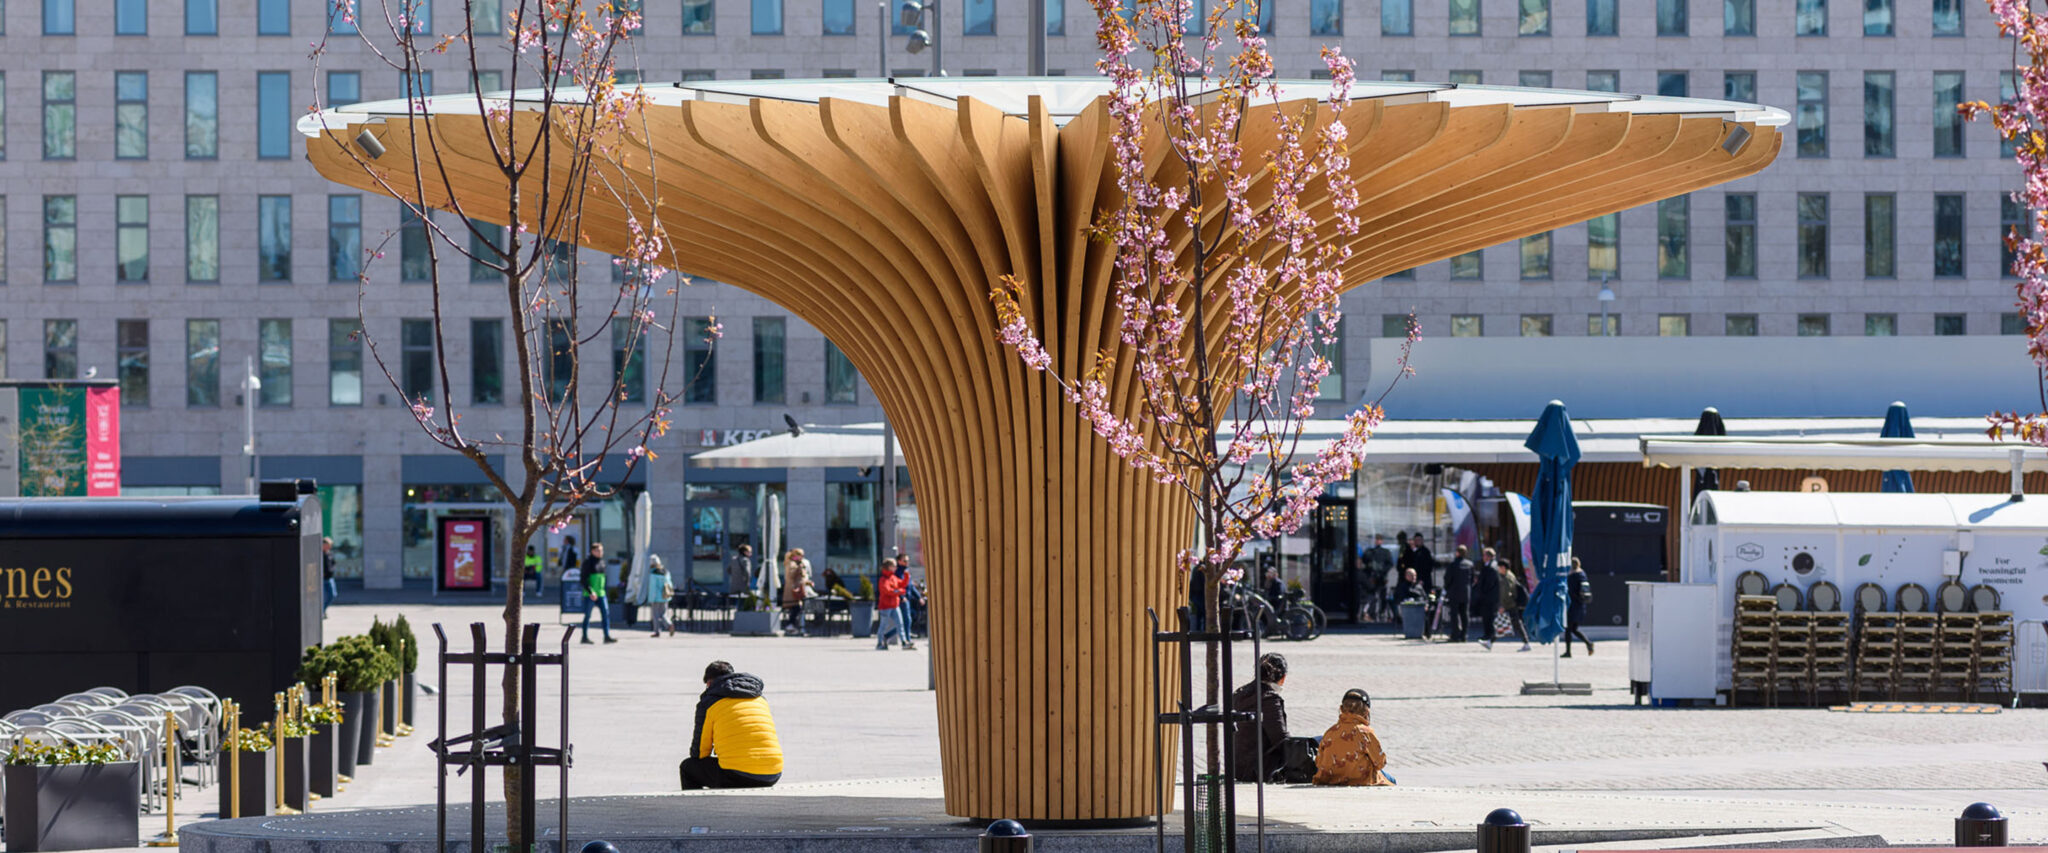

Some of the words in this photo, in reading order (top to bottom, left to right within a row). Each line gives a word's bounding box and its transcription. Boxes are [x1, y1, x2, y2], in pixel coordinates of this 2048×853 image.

[721, 429, 771, 446] KFC
[1995, 557, 2010, 565] For
[0, 567, 72, 599] nes
[4, 600, 11, 608] &
[16, 600, 71, 608] Restaurant
